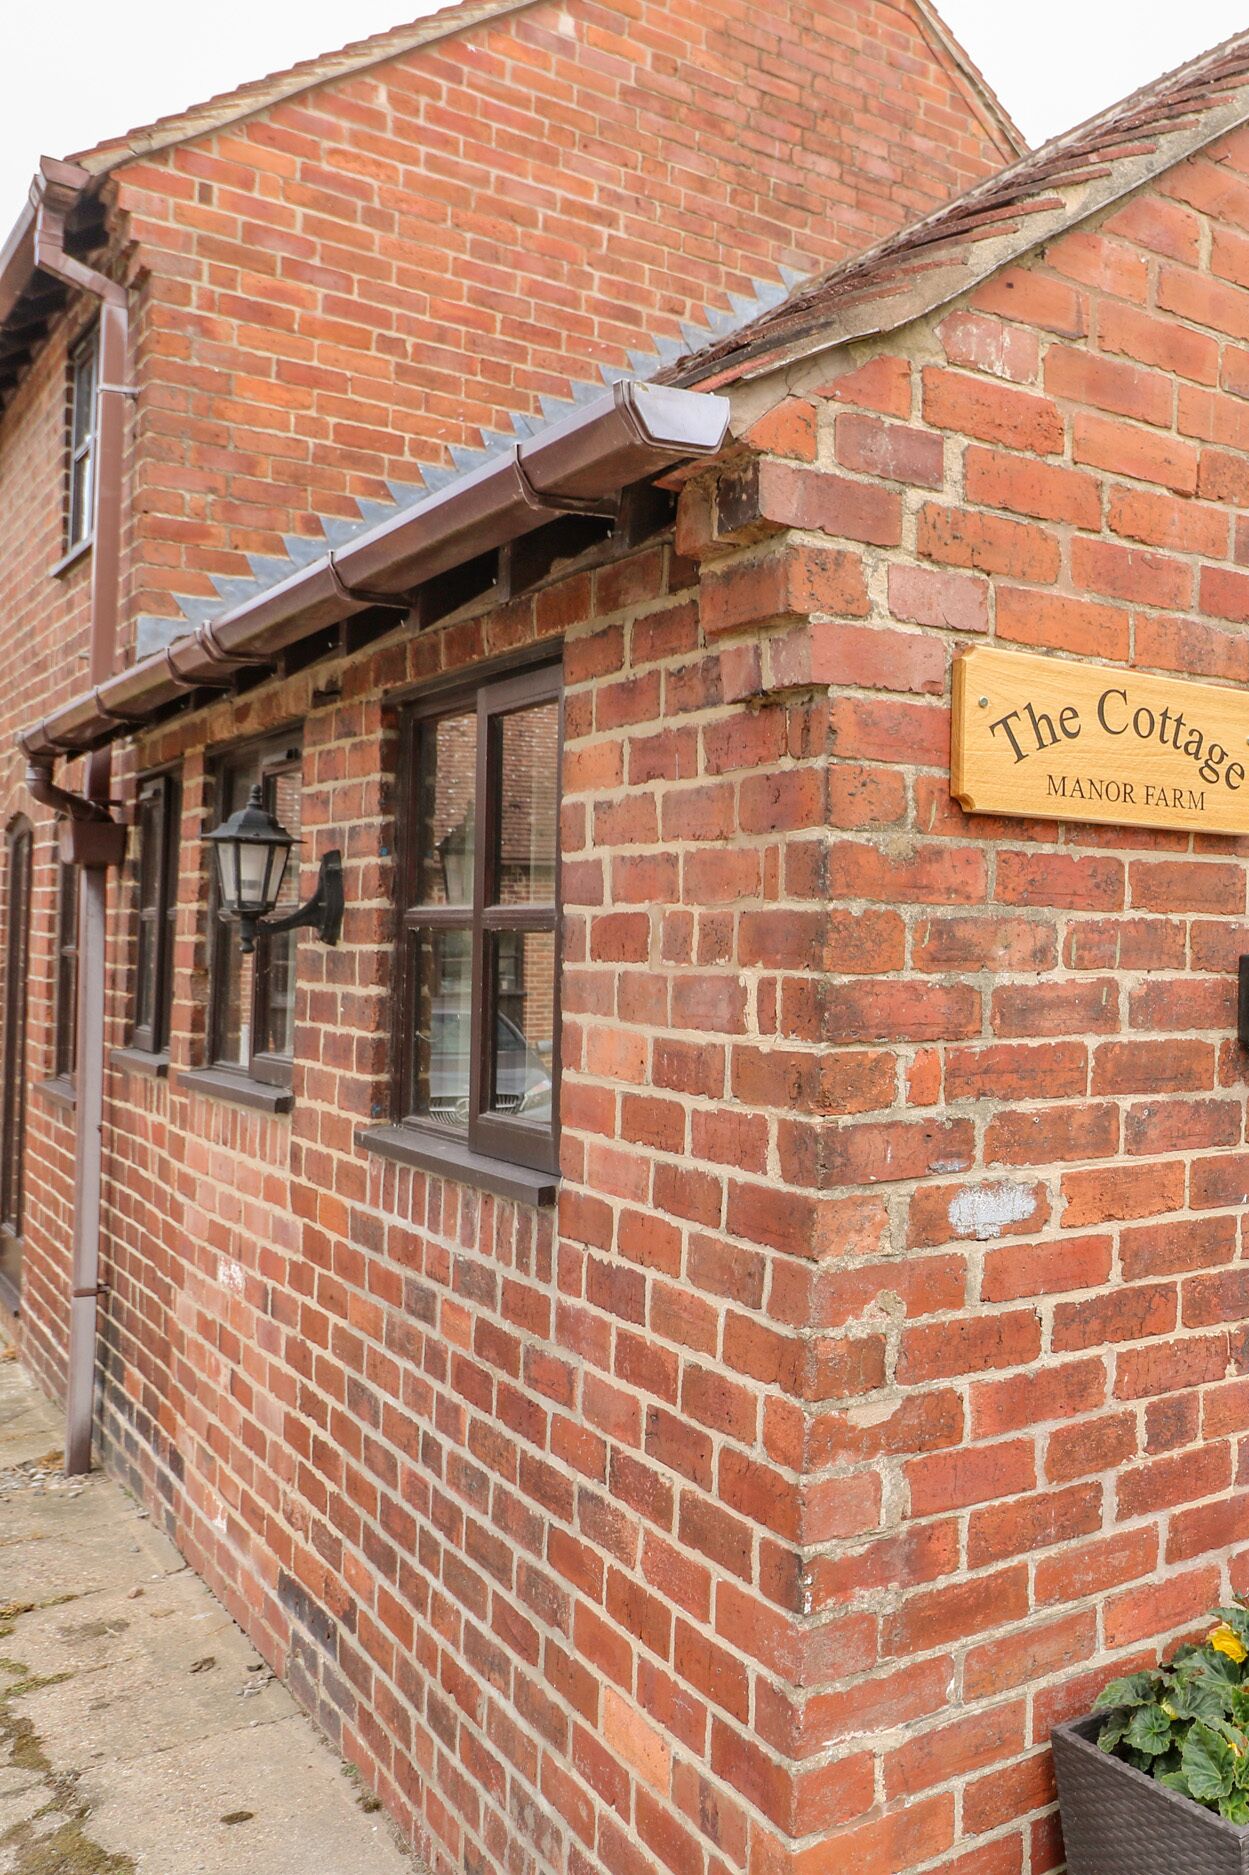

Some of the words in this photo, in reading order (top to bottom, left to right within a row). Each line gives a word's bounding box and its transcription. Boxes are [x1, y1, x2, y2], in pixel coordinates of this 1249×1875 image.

[989, 702, 1081, 764] The
[1097, 689, 1245, 790] Cottage
[1046, 774, 1137, 804] MANOR
[1144, 785, 1206, 811] FARM
